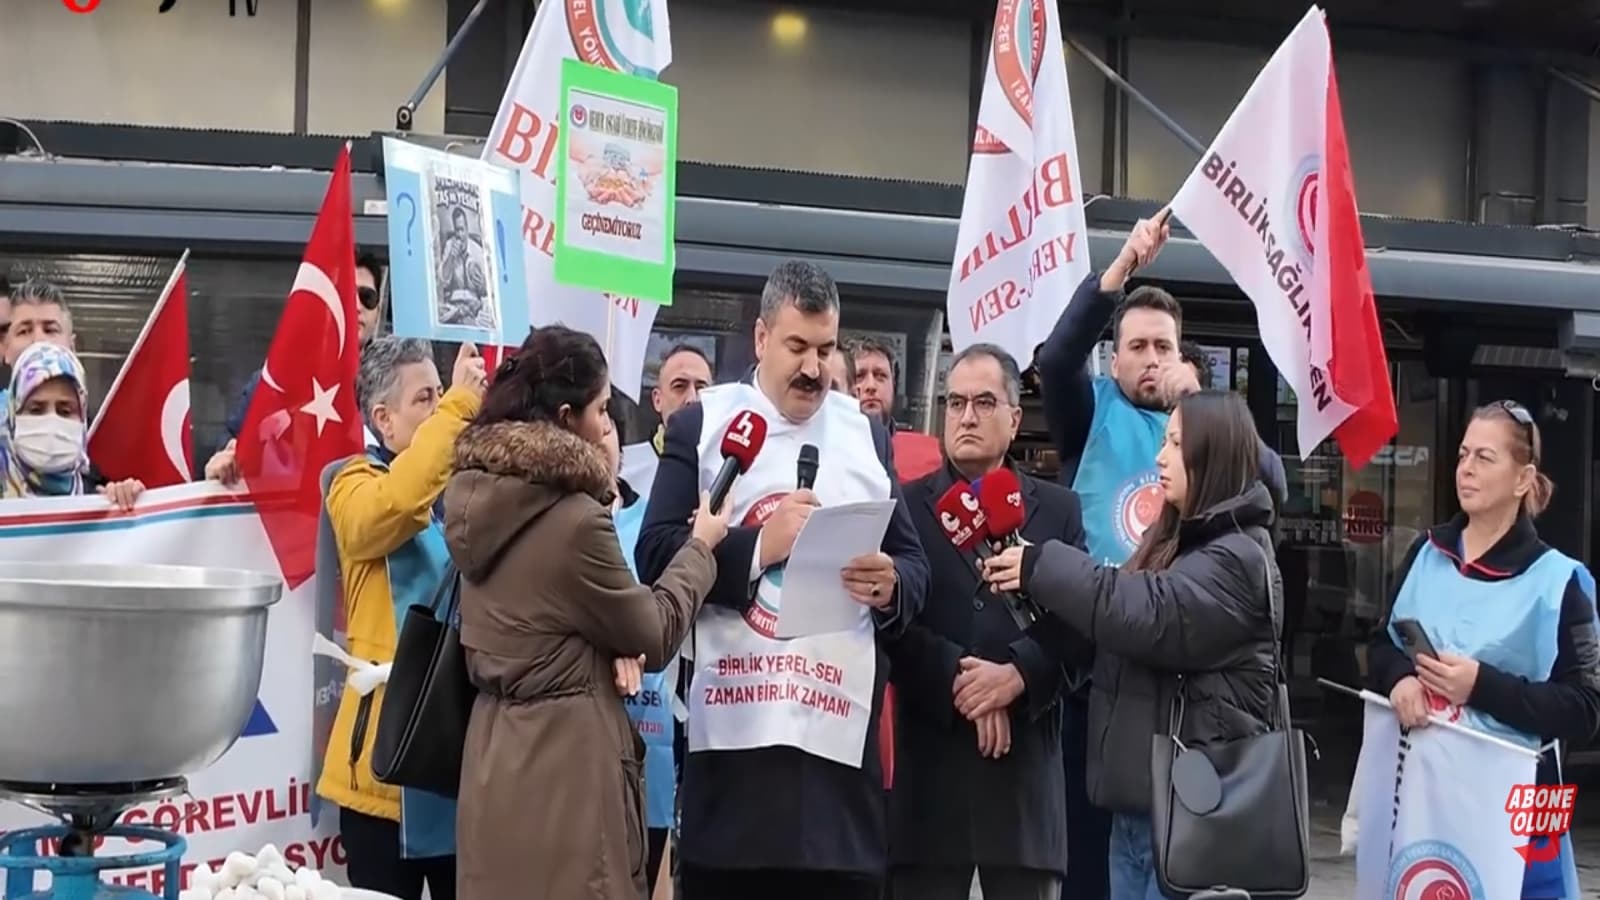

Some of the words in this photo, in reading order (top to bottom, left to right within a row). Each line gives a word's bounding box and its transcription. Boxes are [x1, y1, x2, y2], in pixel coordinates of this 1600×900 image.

[718, 652, 763, 677] BİRLİK
[767, 655, 844, 687] YEREL-SEN
[704, 685, 755, 706] ZAMAN
[757, 678, 799, 702] BİRLİK
[801, 688, 852, 719] ZAMANI
